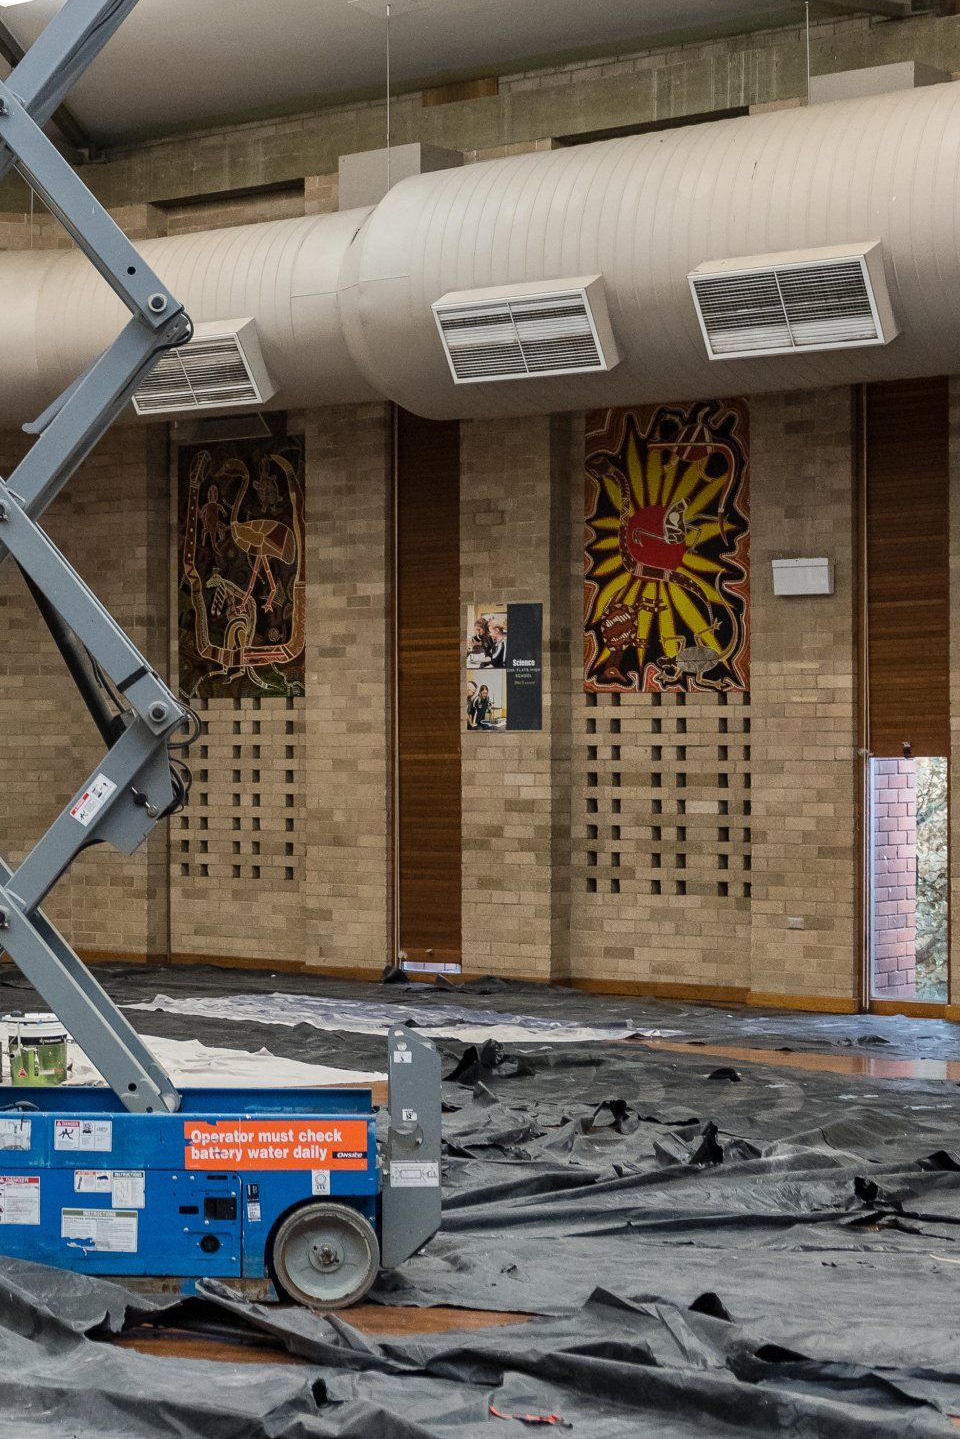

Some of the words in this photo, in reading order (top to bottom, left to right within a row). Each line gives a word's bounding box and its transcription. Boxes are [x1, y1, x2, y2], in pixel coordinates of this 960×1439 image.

[512, 658, 536, 667] Science
[190, 1129, 254, 1145] Operator
[258, 1129, 294, 1143] must
[298, 1128, 342, 1143] check
[191, 1145, 242, 1161] battery
[247, 1146, 289, 1159] water
[293, 1145, 328, 1161] daily
